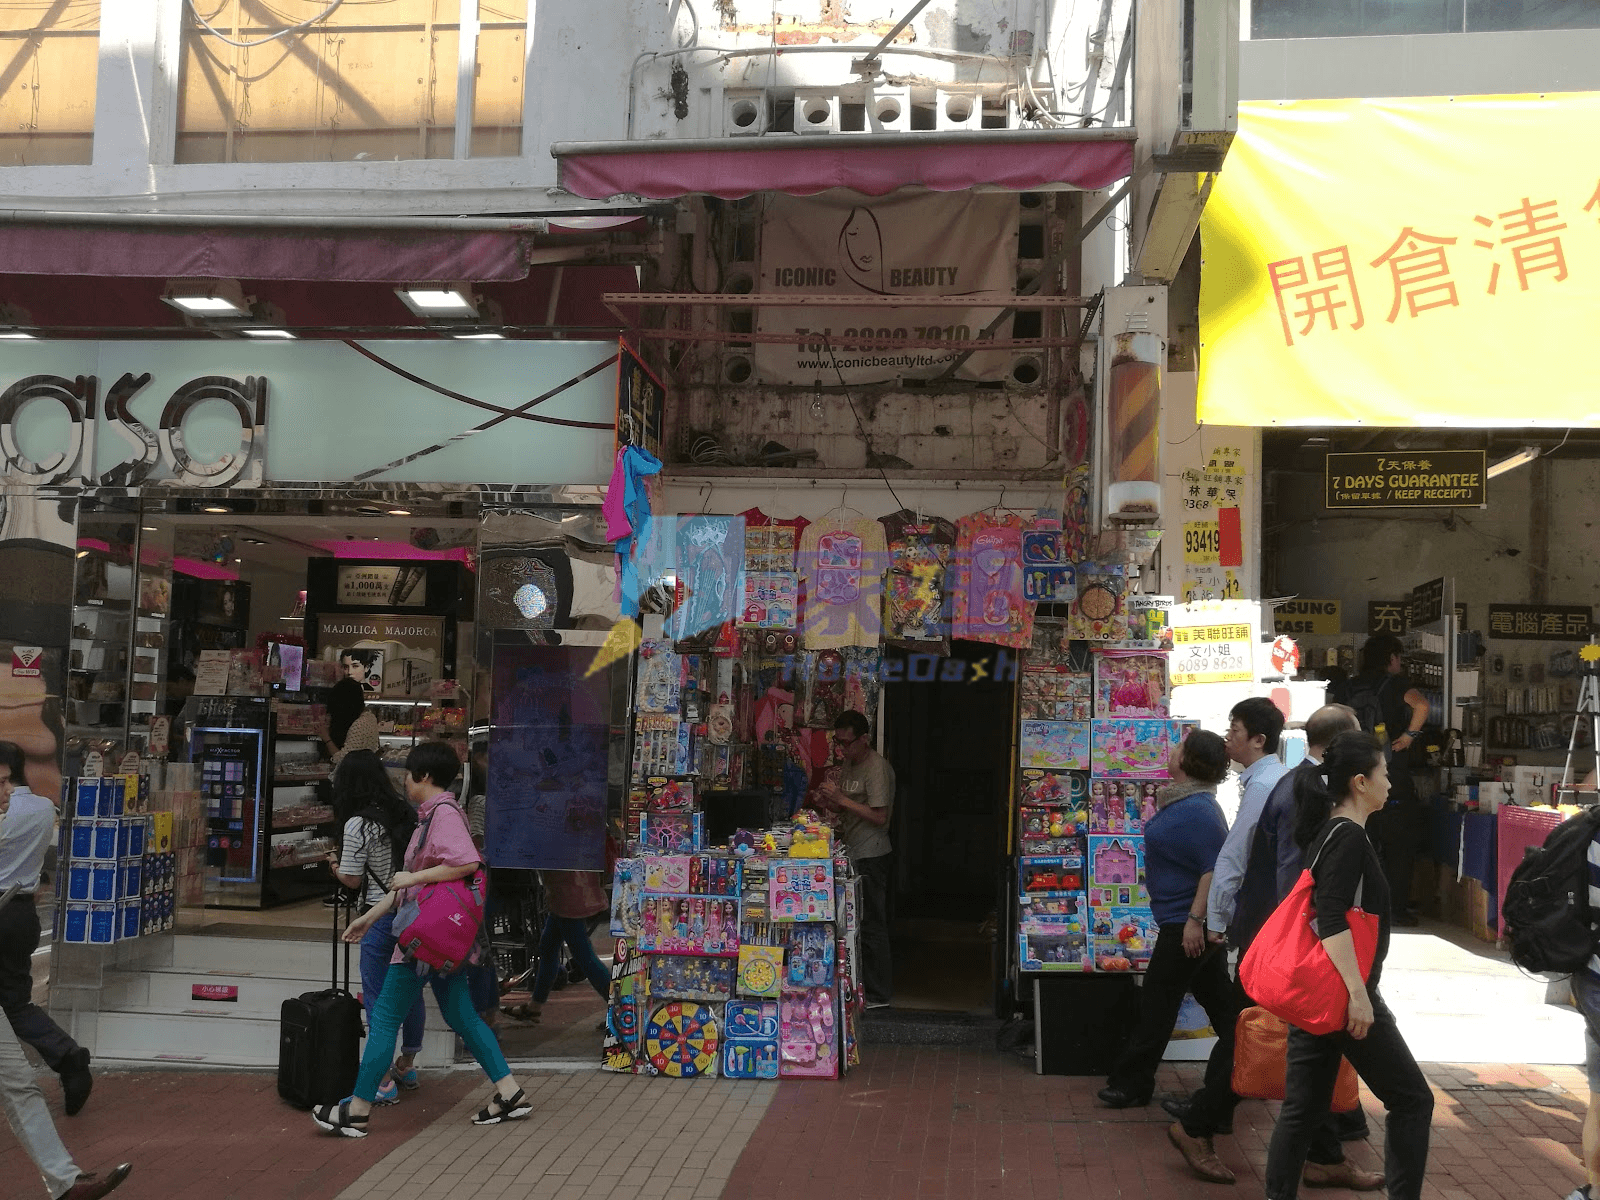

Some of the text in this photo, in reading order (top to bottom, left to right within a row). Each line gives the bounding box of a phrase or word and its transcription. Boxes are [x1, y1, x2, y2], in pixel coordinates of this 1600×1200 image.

[1267, 178, 1600, 346] 開倉清
[775, 266, 959, 287] ICONIC BEAUTY
[1377, 458, 1433, 471] 7天保養
[1332, 473, 1479, 489] 7 DAYS GUARANTEE
[1394, 489, 1421, 499] KEEP
[1155, 599, 1173, 607] BIRDS
[323, 624, 438, 637] MAJOLICA MAJORCA
[1274, 620, 1315, 633] CASE
[1489, 611, 1589, 636] 電腦產品
[1189, 643, 1231, 658] 文小姐
[1178, 655, 1243, 673] 6089 8628
